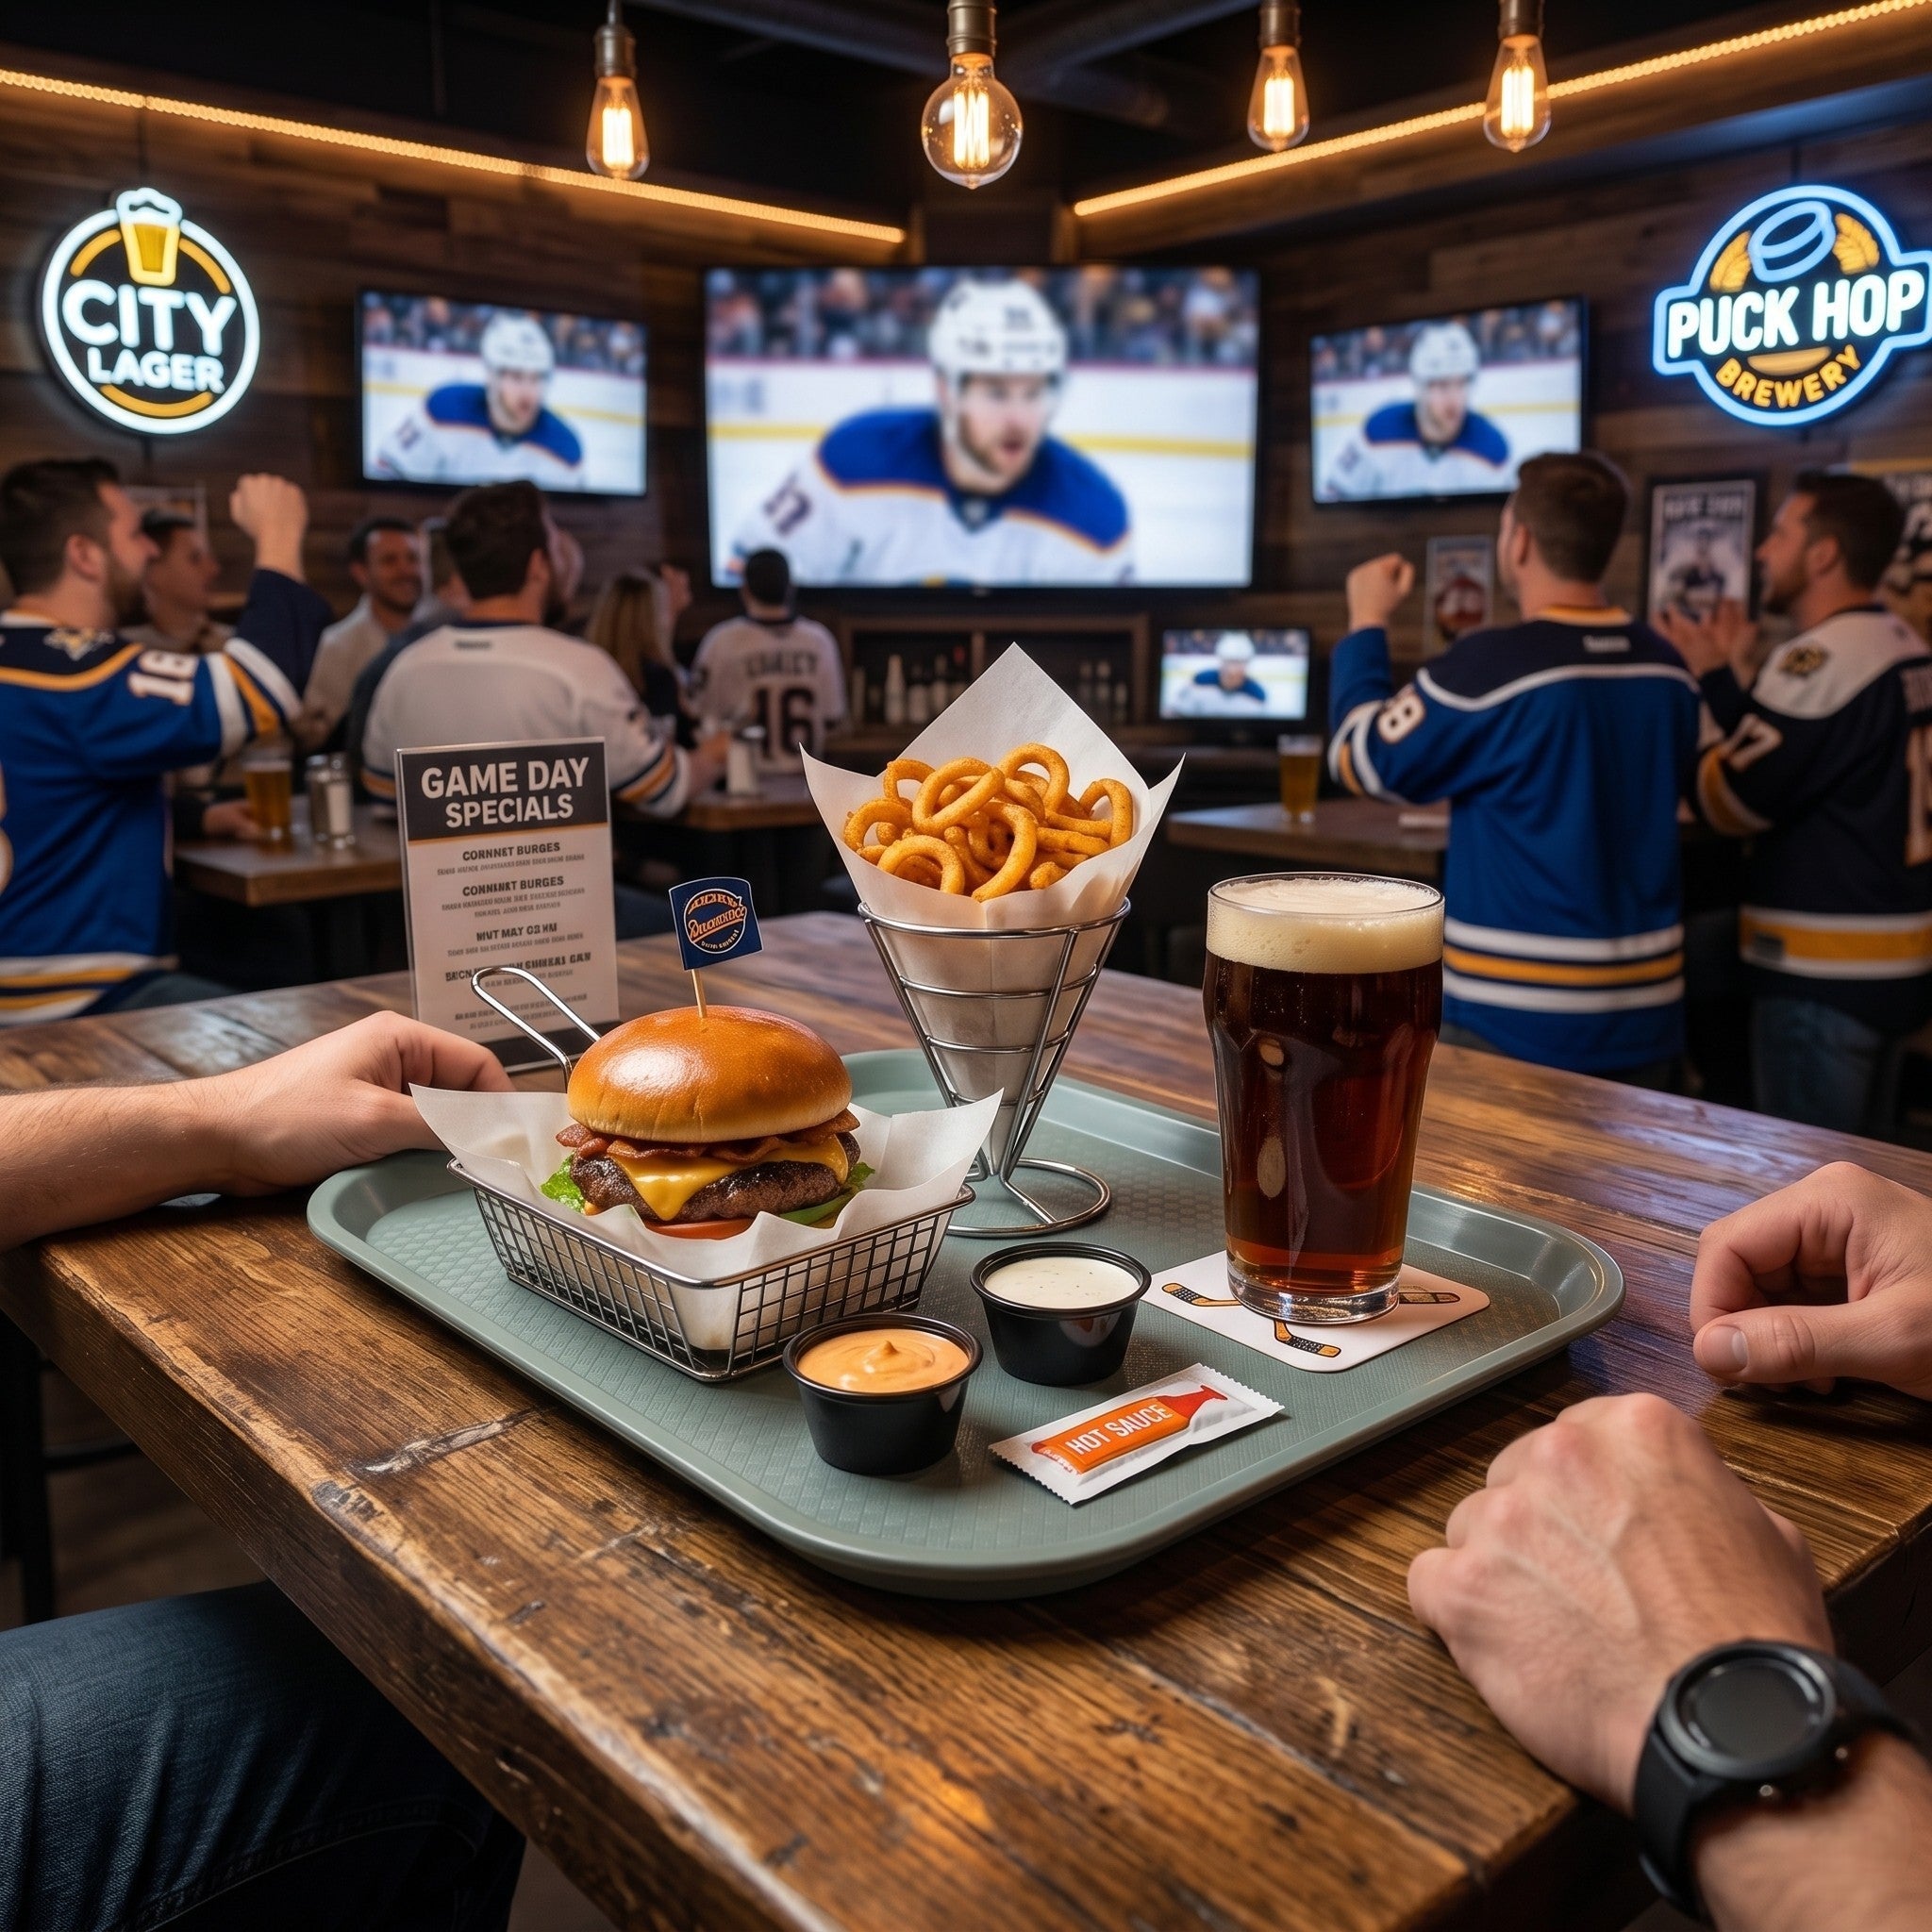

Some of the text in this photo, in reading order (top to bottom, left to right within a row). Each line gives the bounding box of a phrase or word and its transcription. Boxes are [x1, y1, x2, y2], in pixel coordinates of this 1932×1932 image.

[61, 280, 237, 356] CITY
[1667, 269, 1924, 358] PUCK HOP
[86, 346, 225, 393] LAGER
[1715, 343, 1861, 408] BREWERY
[756, 687, 815, 759] 16
[421, 757, 590, 799] GAME DAY
[445, 793, 574, 828] SPECIALS
[517, 841, 560, 856] BURGES
[520, 875, 564, 890] BURGES
[1064, 1403, 1174, 1456] HOT SAUCE
